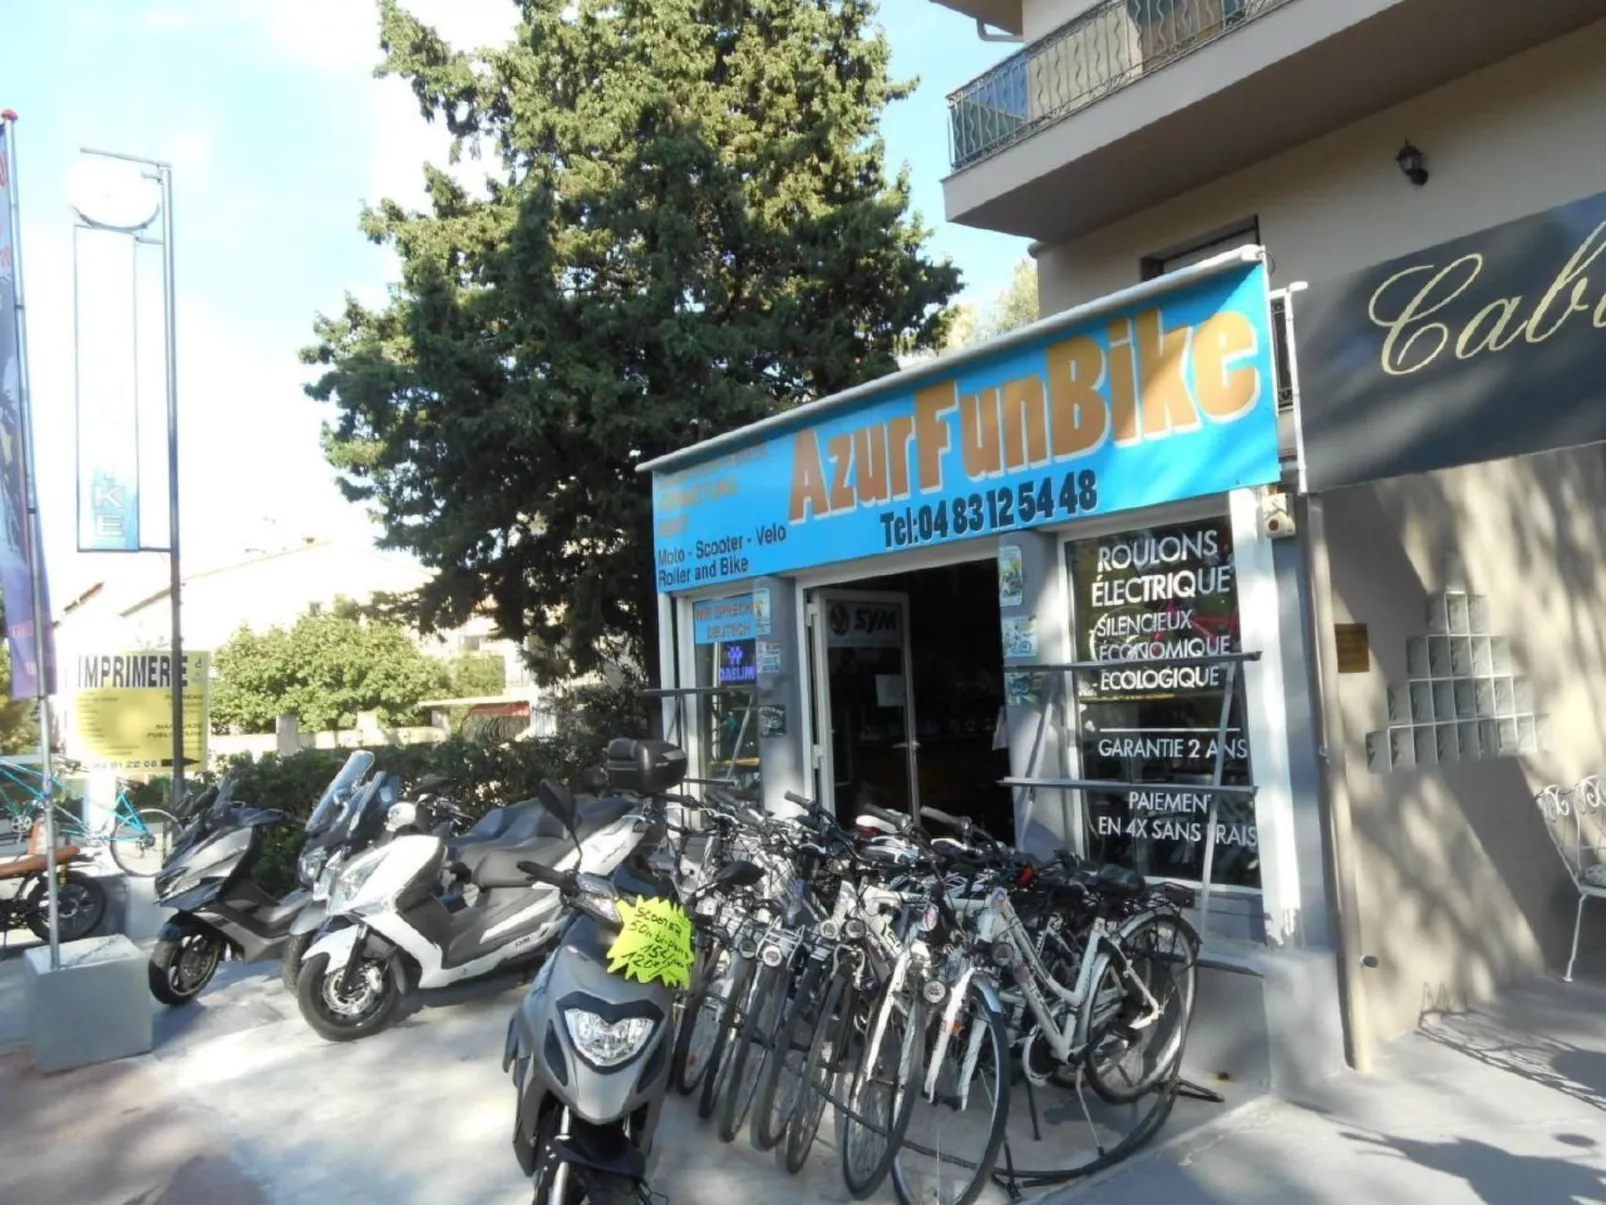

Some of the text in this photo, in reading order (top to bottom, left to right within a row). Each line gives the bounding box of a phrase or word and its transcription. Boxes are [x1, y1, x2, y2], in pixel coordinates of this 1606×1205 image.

[1368, 219, 1606, 376] Cab
[788, 307, 1260, 526] AzurFunBike
[952, 493, 985, 534] 83
[986, 487, 1015, 529] 12
[1018, 477, 1054, 523] 54
[1059, 469, 1098, 514] 48
[658, 547, 685, 567] Moto
[695, 535, 744, 560] Scooter
[755, 523, 787, 546] Velo
[1097, 530, 1219, 573] ROULONS
[658, 556, 749, 587] Roller and Bike
[1092, 565, 1231, 608] ÉLECTRIQUE
[854, 606, 897, 634] SYM
[1096, 609, 1193, 637] SILENCIEUX
[1099, 635, 1231, 662] ÉCONOMIQUE
[78, 655, 189, 688] IMPRIMERE
[1098, 738, 1184, 758] GARANTIE
[1187, 738, 1201, 758] 2
[1128, 791, 1212, 814] PAIEMEN
[1098, 816, 1258, 847] EN 4X SANS RAIS
